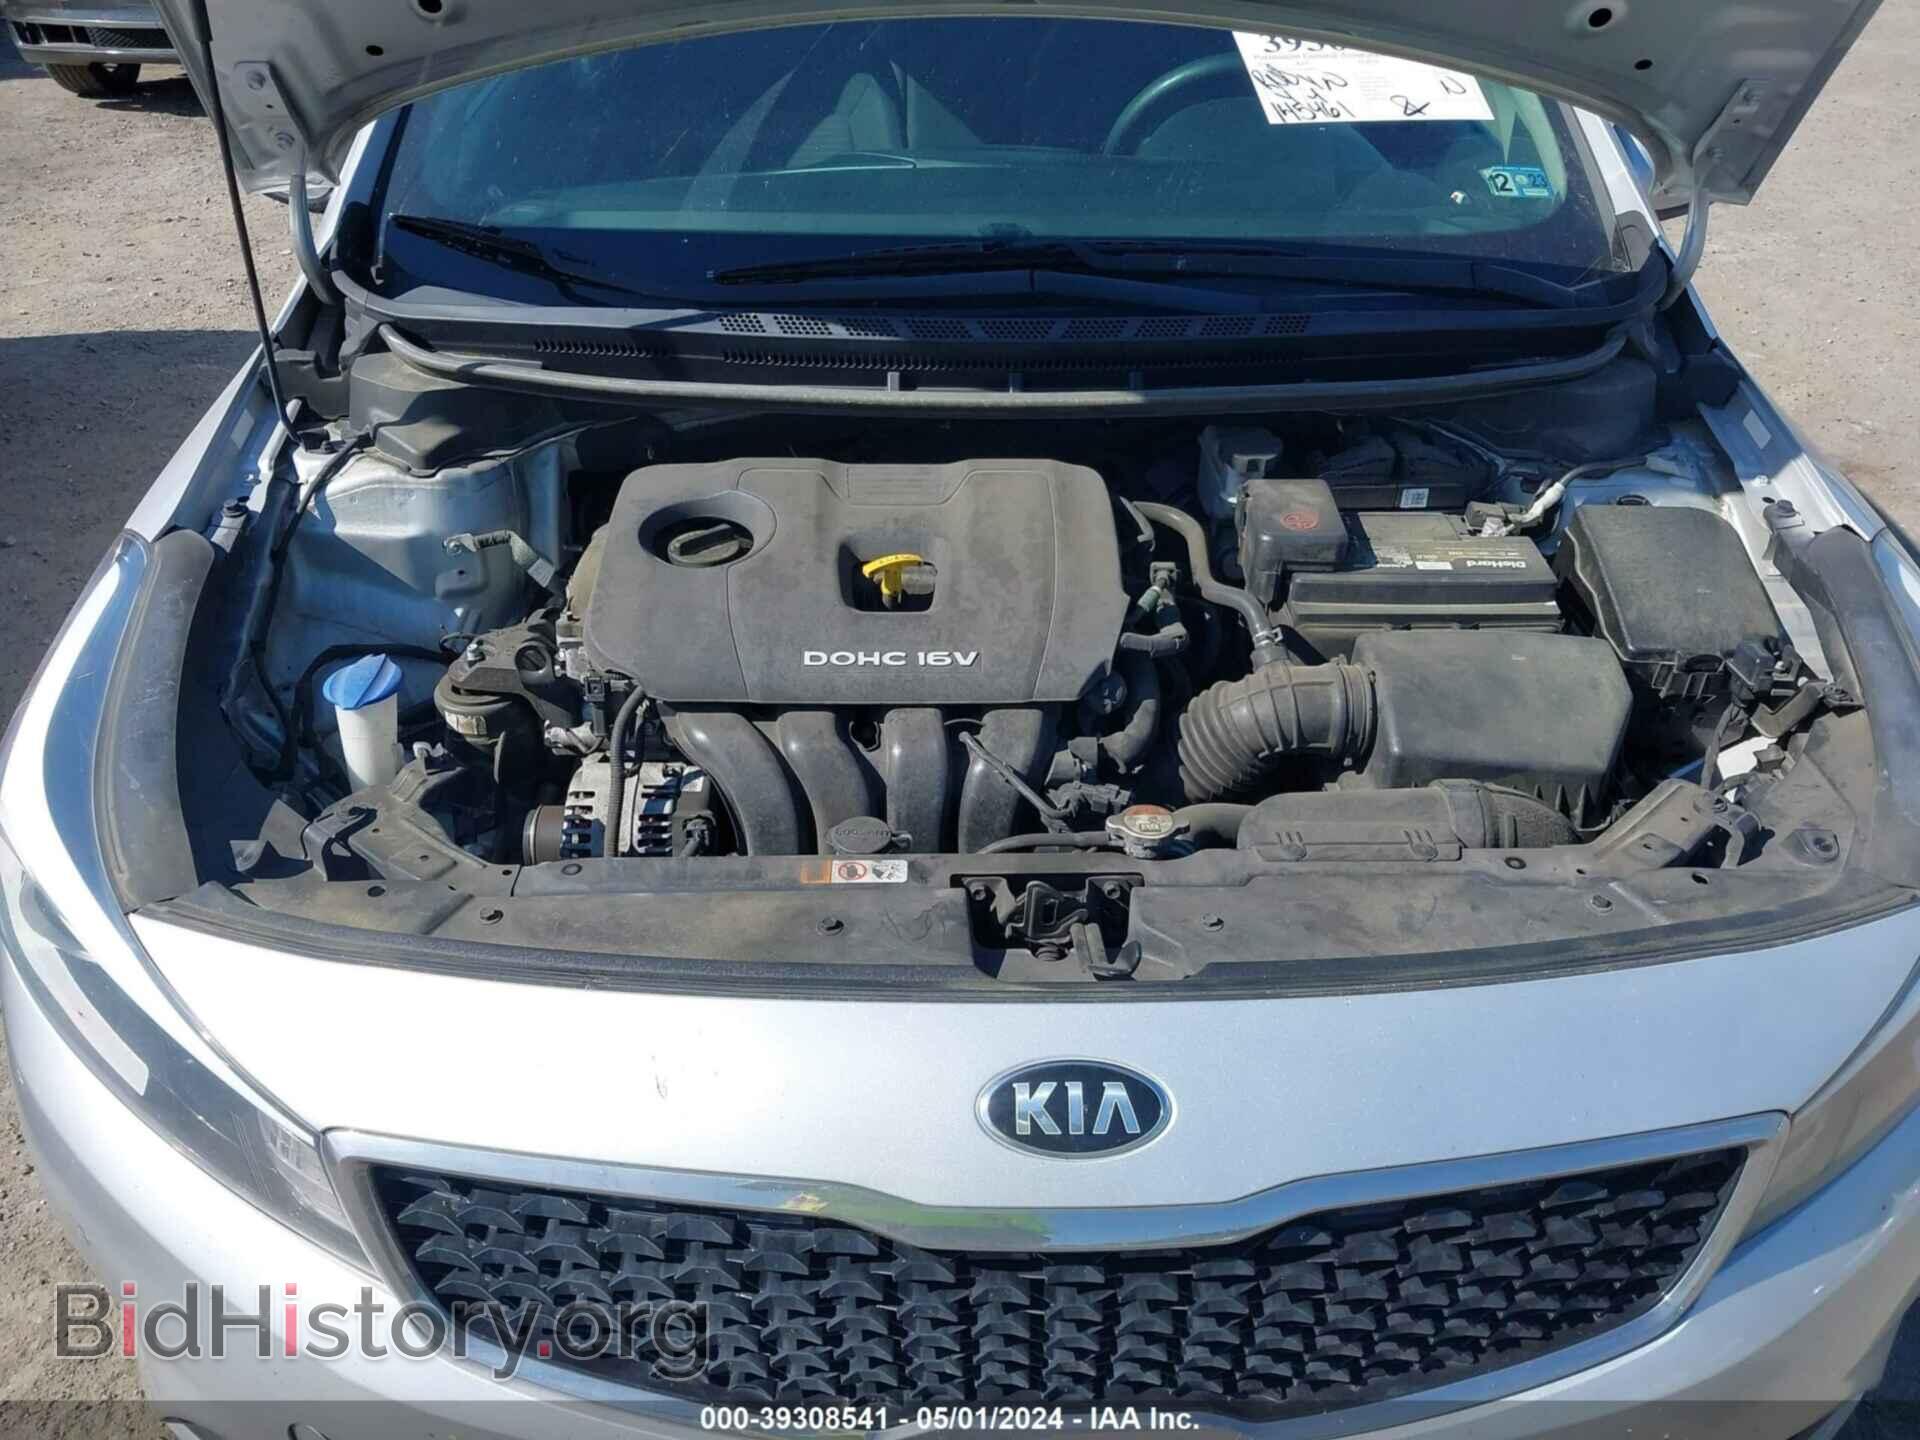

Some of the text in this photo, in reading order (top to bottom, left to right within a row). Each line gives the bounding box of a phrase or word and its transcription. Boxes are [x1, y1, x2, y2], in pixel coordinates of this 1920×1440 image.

[1488, 173, 1513, 192] 12
[803, 651, 978, 666] DOHC 16V
[1012, 1082, 1141, 1135] KIA
